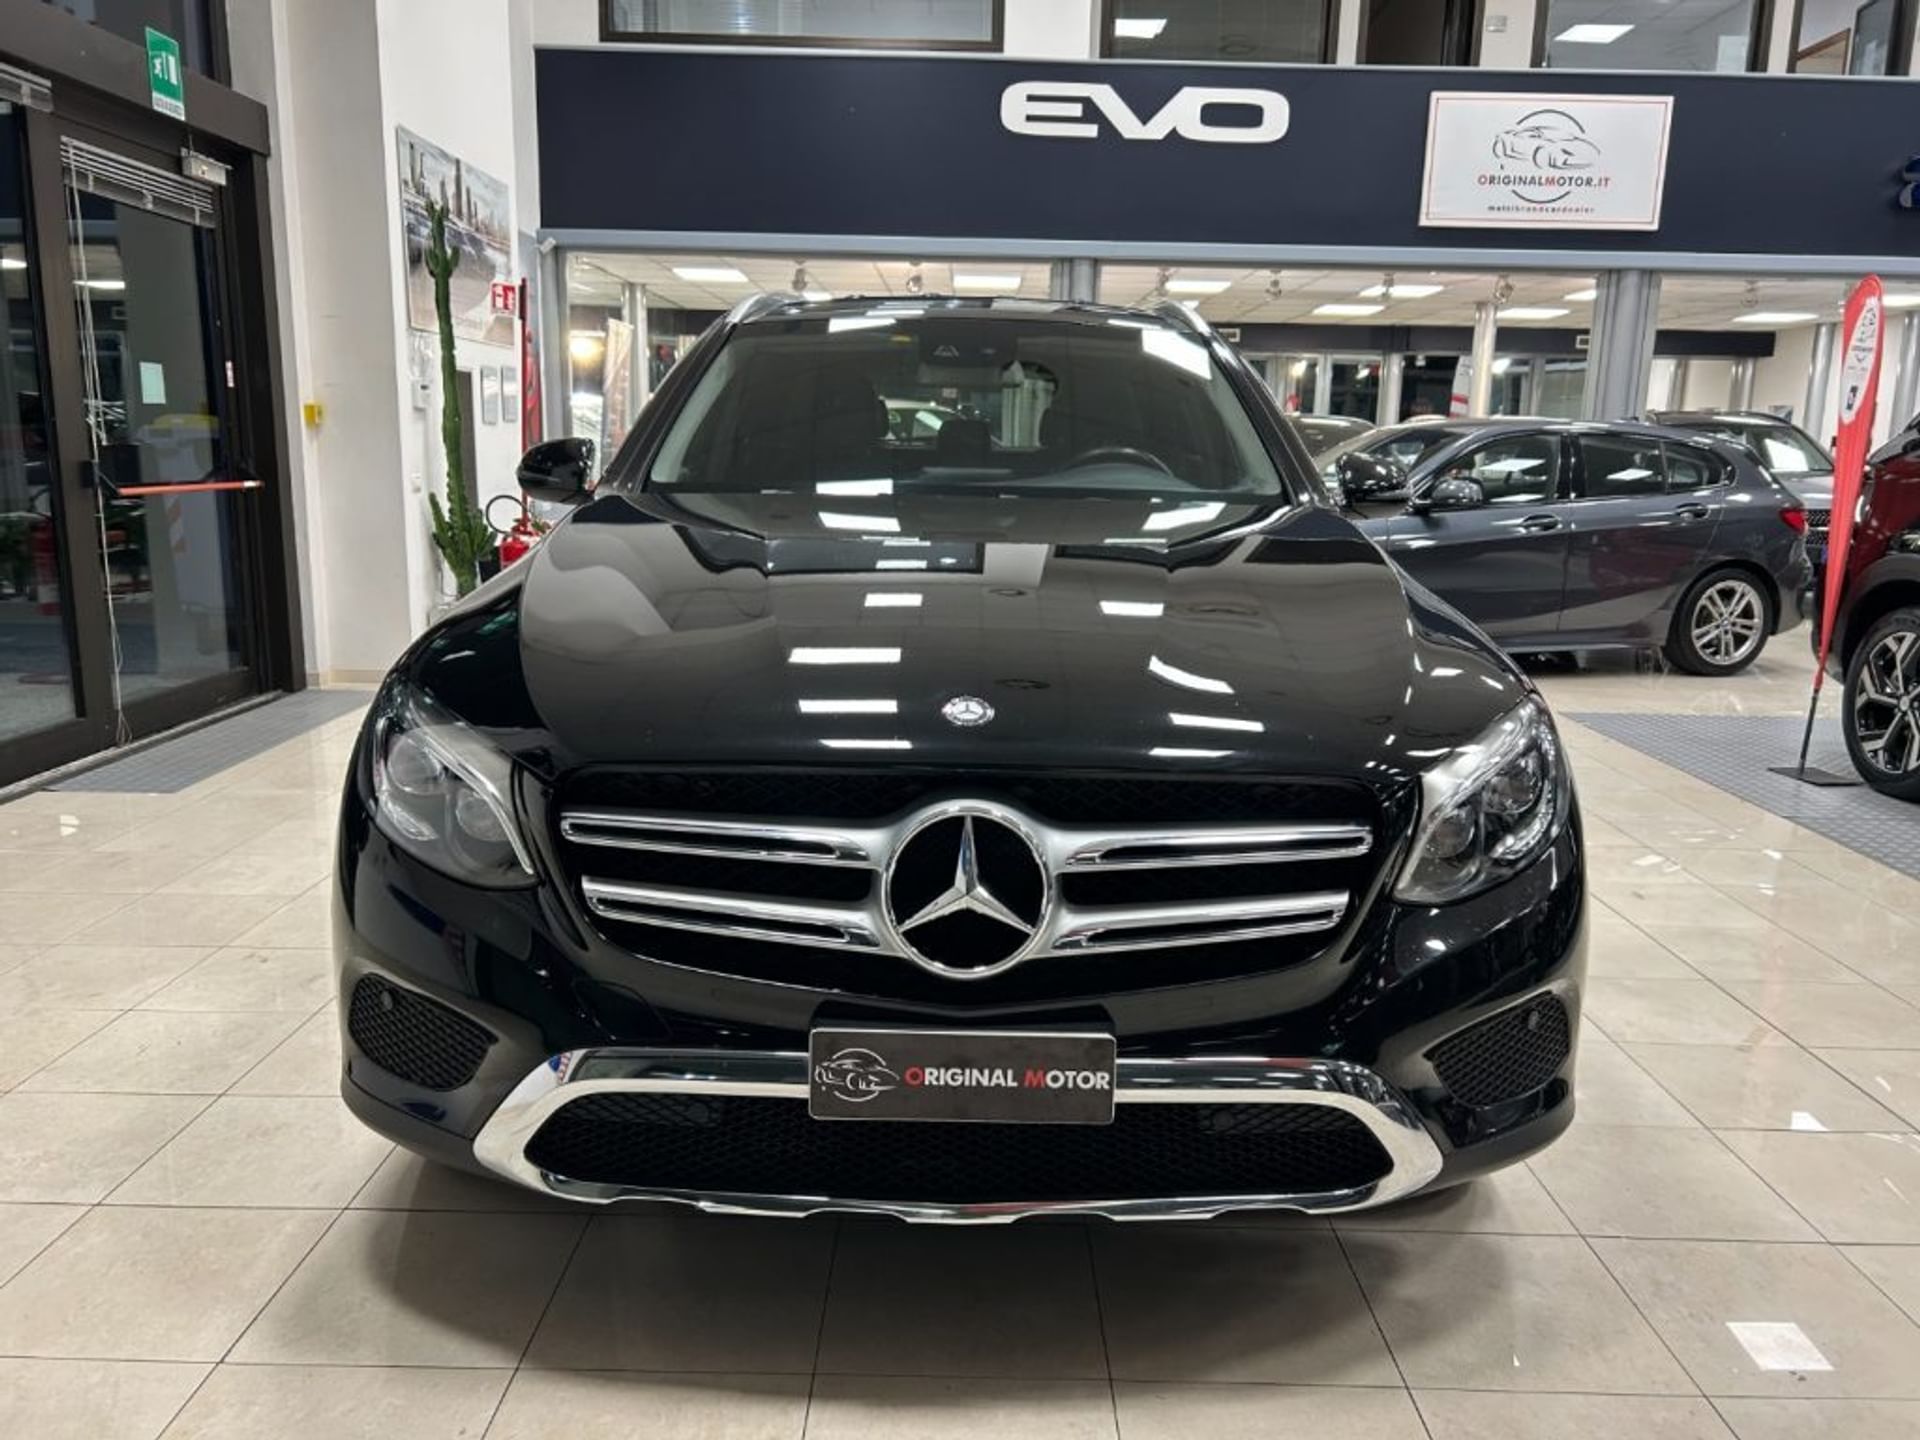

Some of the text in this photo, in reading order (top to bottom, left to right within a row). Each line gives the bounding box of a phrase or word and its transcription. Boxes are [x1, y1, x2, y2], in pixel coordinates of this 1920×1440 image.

[1000, 81, 1290, 143] EVO
[1477, 174, 1611, 188] ORIGINALMOTOR.IT
[904, 1066, 1111, 1090] ORIGINAL MOTOR
